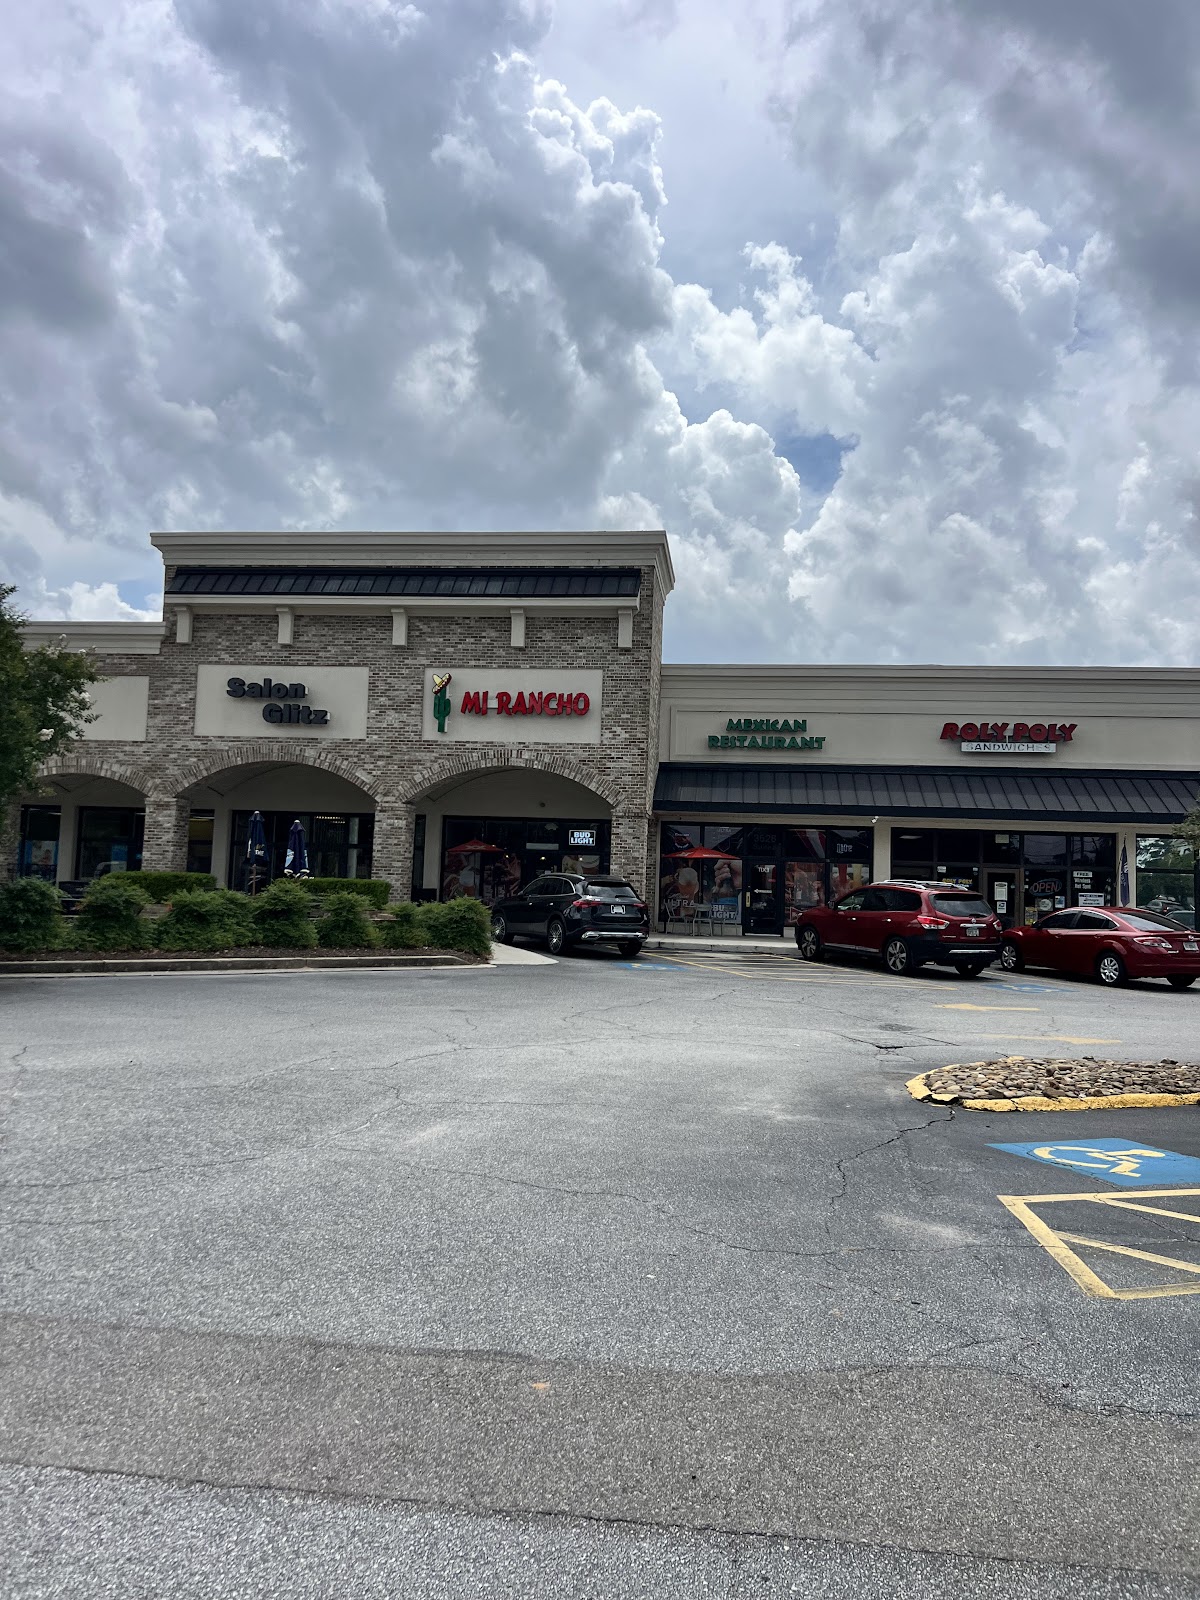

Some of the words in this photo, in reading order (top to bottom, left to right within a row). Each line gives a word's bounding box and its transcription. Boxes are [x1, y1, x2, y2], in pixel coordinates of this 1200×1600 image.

[226, 677, 307, 699] Salon
[460, 690, 489, 716] MI
[495, 691, 590, 716] RANCHO
[262, 703, 328, 725] Glitz
[726, 718, 807, 733] MEXICAN
[940, 722, 1009, 741] ROLY
[1013, 722, 1078, 742] POLY
[708, 735, 826, 749] RESTAURANT
[965, 743, 1051, 751] SANDWICHES
[570, 837, 594, 845] LIGHT
[1032, 881, 1058, 893] OPEN
